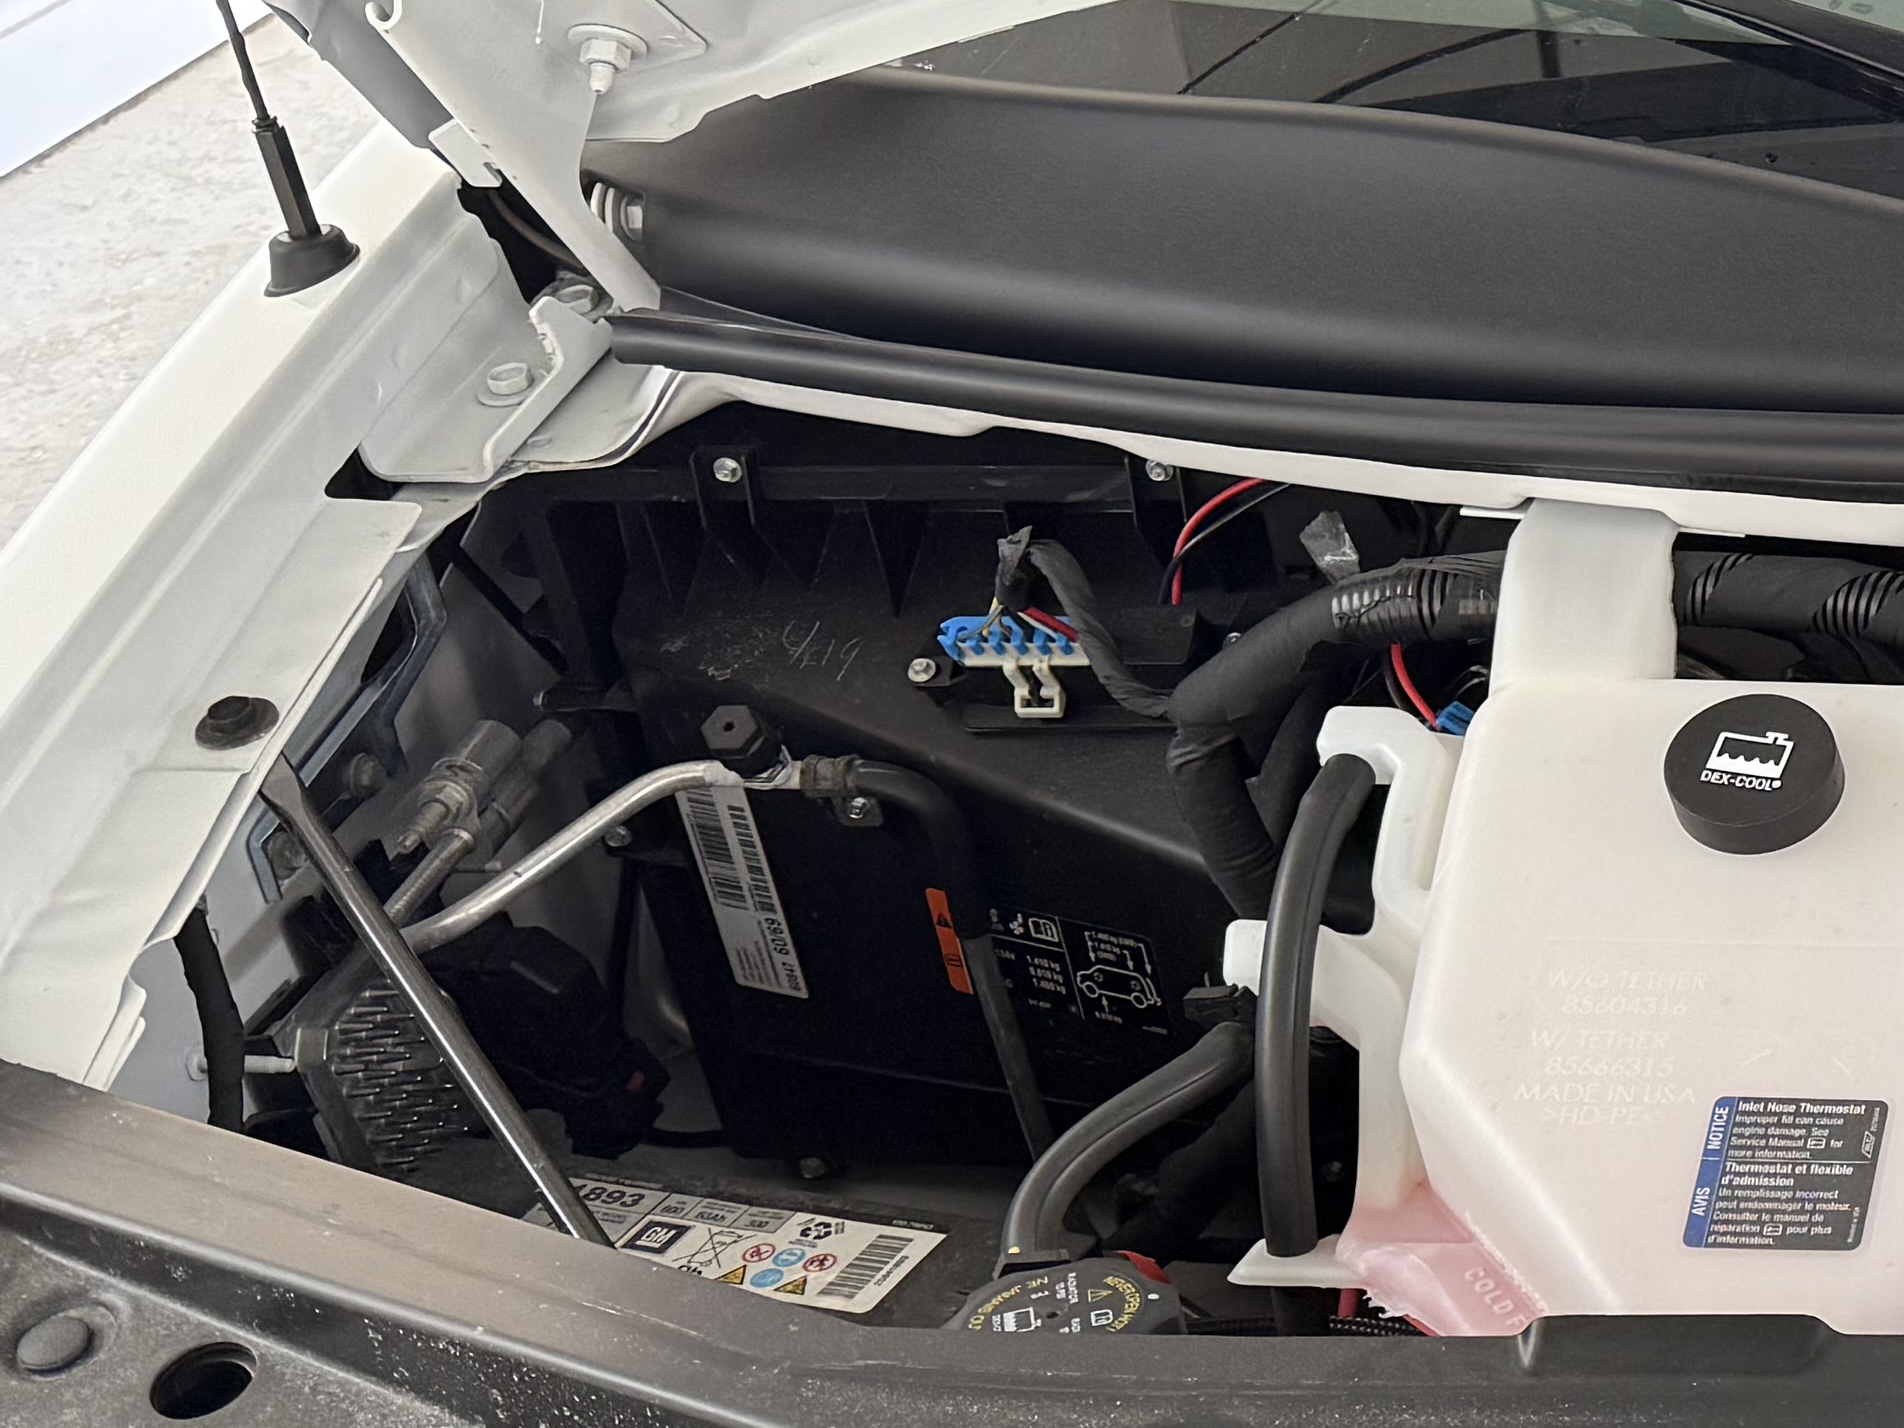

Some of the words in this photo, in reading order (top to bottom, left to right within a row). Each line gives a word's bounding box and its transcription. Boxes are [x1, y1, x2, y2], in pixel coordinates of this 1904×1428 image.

[1514, 1082, 1601, 1103] MADE
[1607, 1083, 1636, 1104] IN
[1643, 1082, 1697, 1105] USA
[1737, 1100, 1765, 1113] Inlet
[1766, 1102, 1796, 1113] Hose
[1799, 1102, 1866, 1115] Thermostat
[1735, 1113, 1778, 1125] Improper
[1795, 1117, 1814, 1125] can
[1815, 1117, 1844, 1126] cause
[1706, 1106, 1730, 1150] NOTICE
[1732, 1126, 1765, 1137] engine
[1730, 1136, 1766, 1147] Service
[1768, 1137, 1805, 1148] Manual
[1727, 1149, 1753, 1158] more
[1724, 1162, 1793, 1174] Thermostat
[1794, 1163, 1808, 1175] et
[1809, 1162, 1854, 1176] flexible
[1718, 1187, 1732, 1197] Un
[1691, 1186, 1711, 1217] AVIS
[1463, 1266, 1515, 1316] COLD
